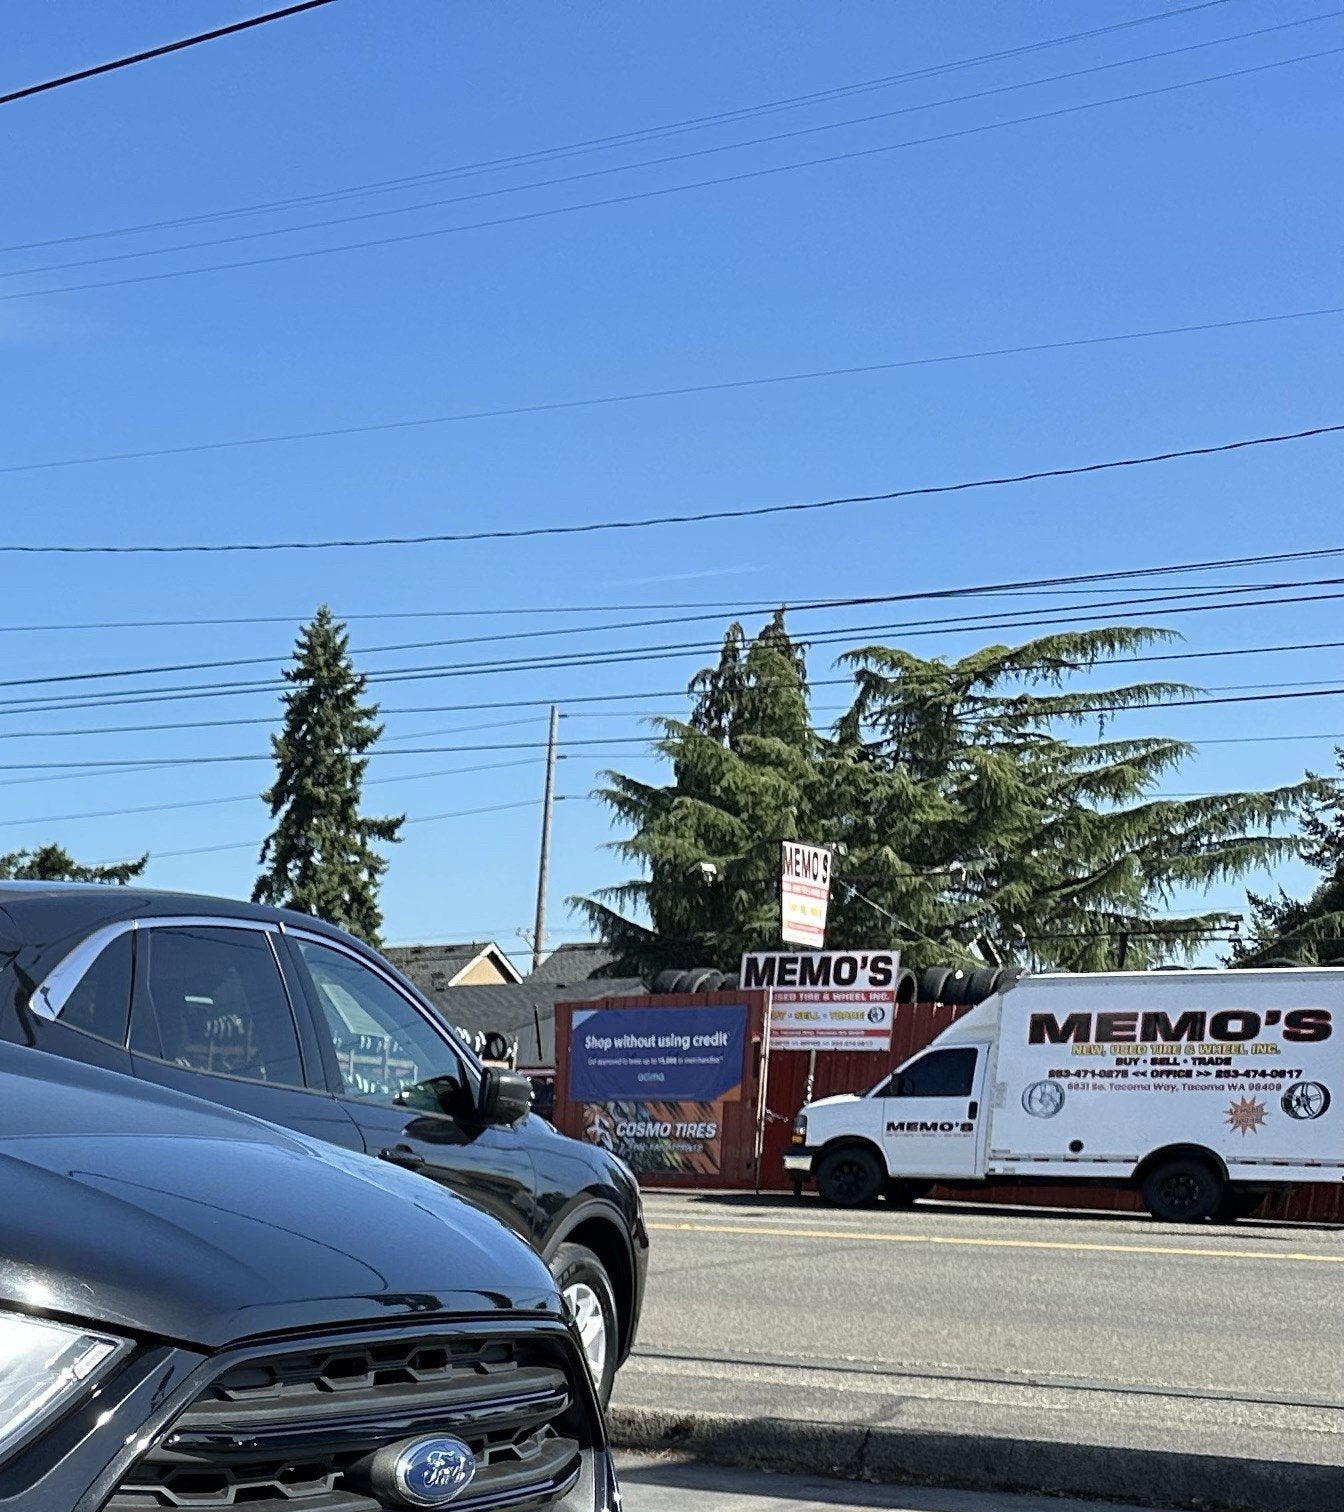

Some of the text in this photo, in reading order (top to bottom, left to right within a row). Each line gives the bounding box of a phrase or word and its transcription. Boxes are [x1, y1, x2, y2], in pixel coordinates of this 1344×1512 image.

[744, 955, 894, 987] MEMO'S
[1028, 1009, 1333, 1044] MEMO'S
[585, 1034, 612, 1051] Shop
[614, 1034, 656, 1048] without
[658, 1033, 690, 1050] using
[1198, 1043, 1248, 1055] WHEEL
[1115, 1057, 1232, 1066] BUY SELL TRADE
[1150, 1069, 1193, 1078] OFFICE
[1109, 1082, 1151, 1091] Tacoma
[1182, 1082, 1225, 1091] Tacoma
[1227, 1082, 1246, 1091] WA
[616, 1121, 717, 1138] COSMO TIRES
[886, 1122, 974, 1132] MEMO'S
[423, 1450, 467, 1488] Ford
